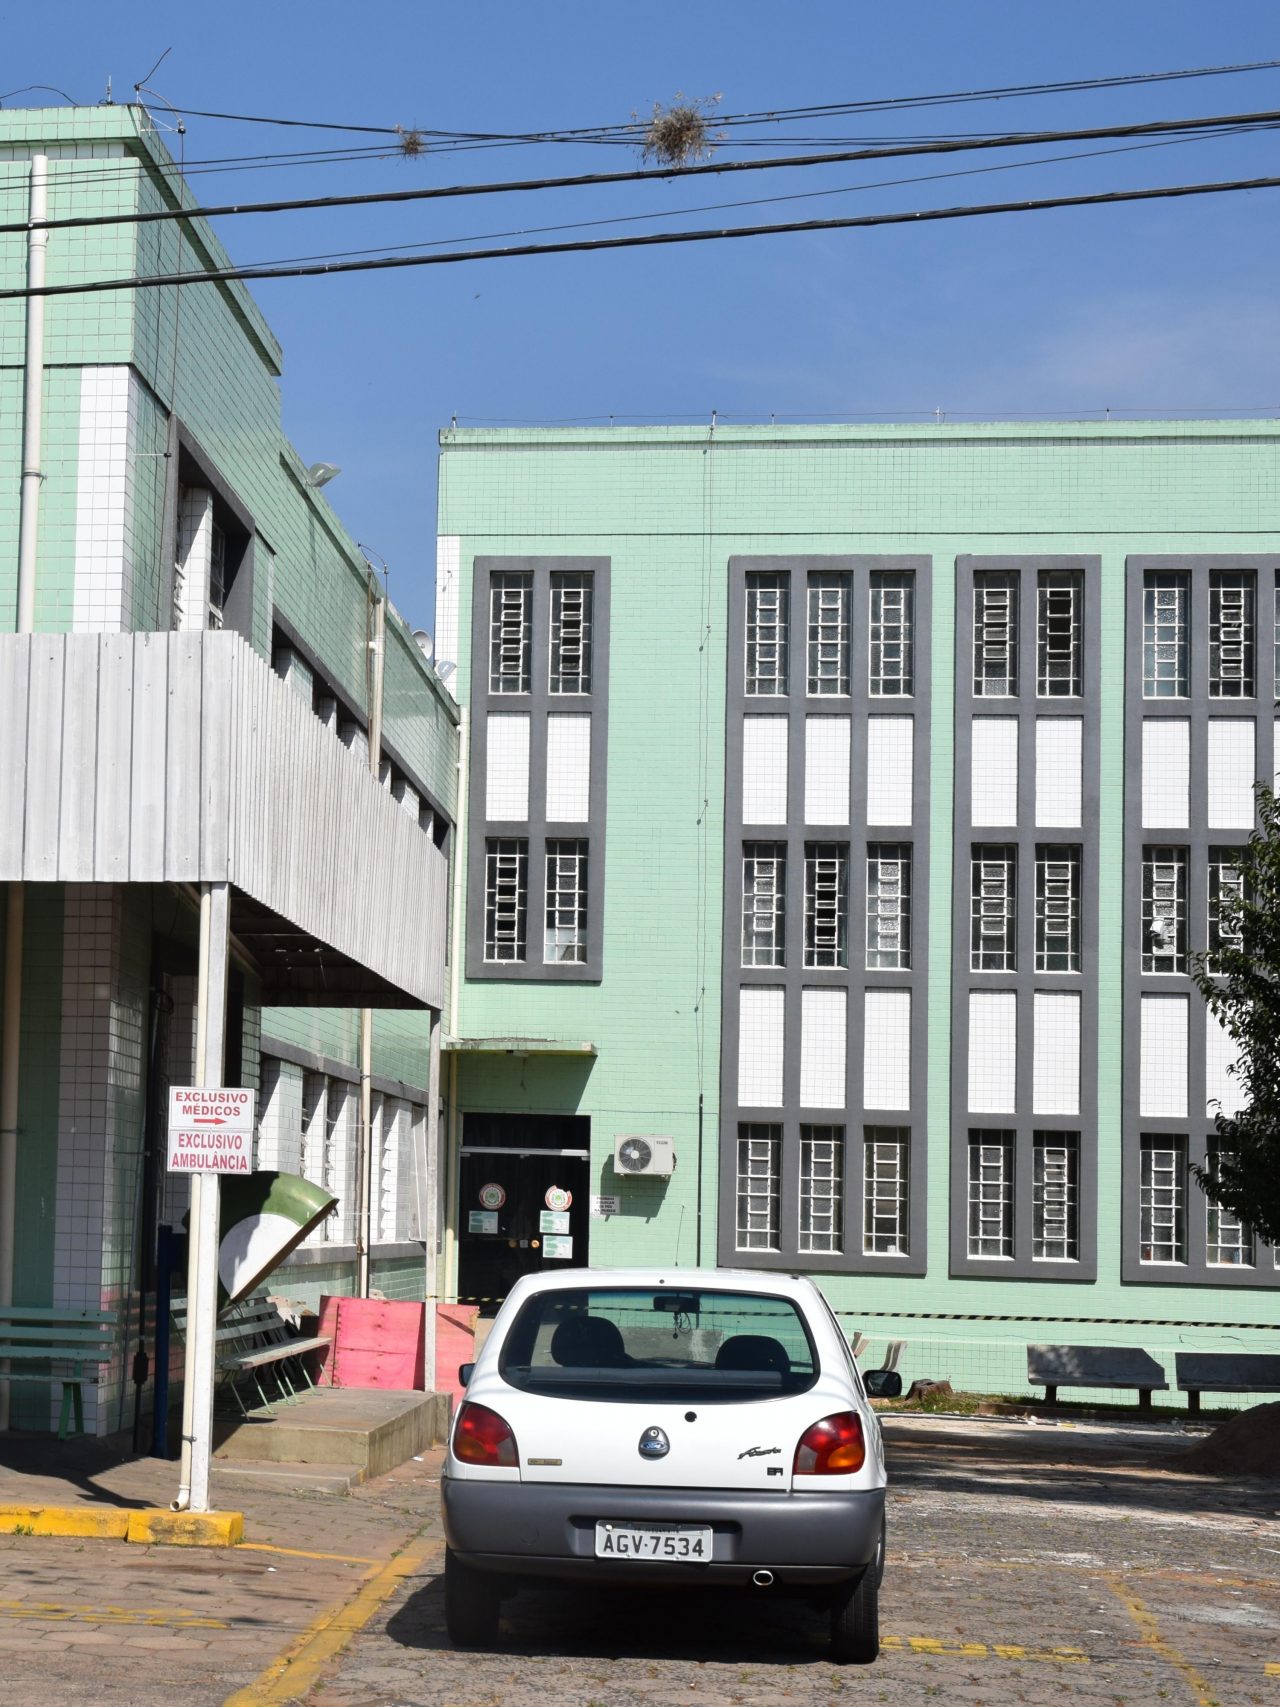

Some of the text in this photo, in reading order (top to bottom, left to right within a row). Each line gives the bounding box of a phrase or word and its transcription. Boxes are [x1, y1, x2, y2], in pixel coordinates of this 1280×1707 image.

[175, 1092, 248, 1104] EXCLUSIVO
[182, 1103, 241, 1117] MÉDICOS
[178, 1133, 243, 1150] EXCLUSIVO
[171, 1151, 248, 1170] AMBULÂNCIA
